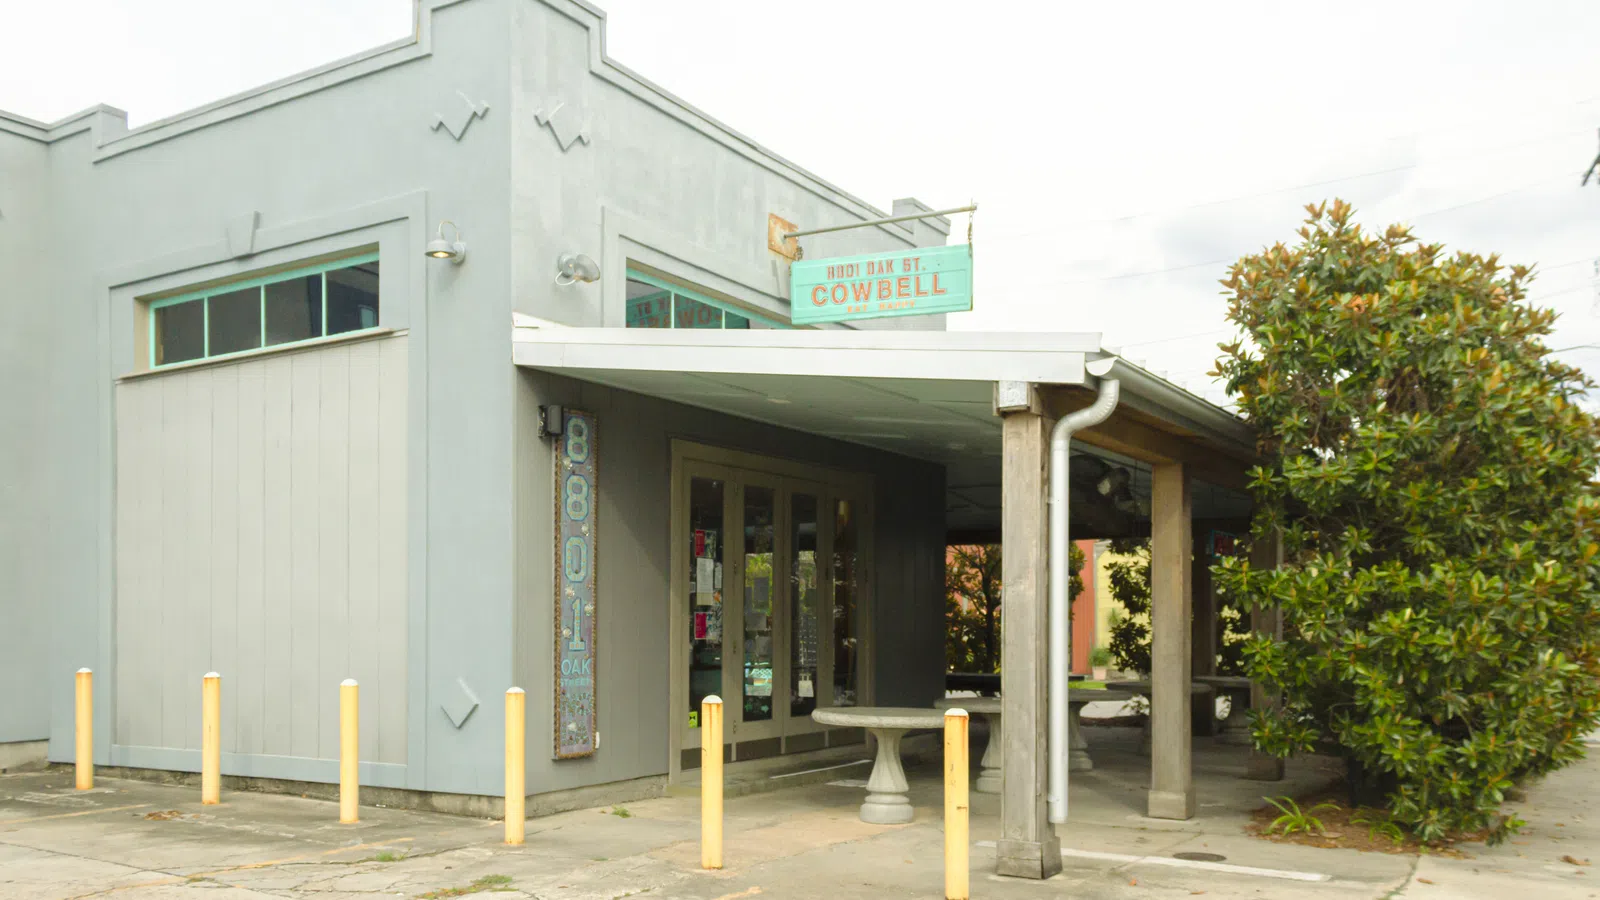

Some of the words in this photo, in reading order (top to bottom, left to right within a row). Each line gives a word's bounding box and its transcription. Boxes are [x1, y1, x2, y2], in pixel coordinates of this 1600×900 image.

[827, 263, 860, 280] 8801
[866, 260, 894, 276] OAK
[903, 257, 926, 272] ST.
[811, 273, 947, 306] COWBELL
[847, 304, 868, 313] EAT
[879, 300, 916, 312] HAPPY
[561, 658, 591, 676] OAK
[560, 677, 592, 687] STREET
